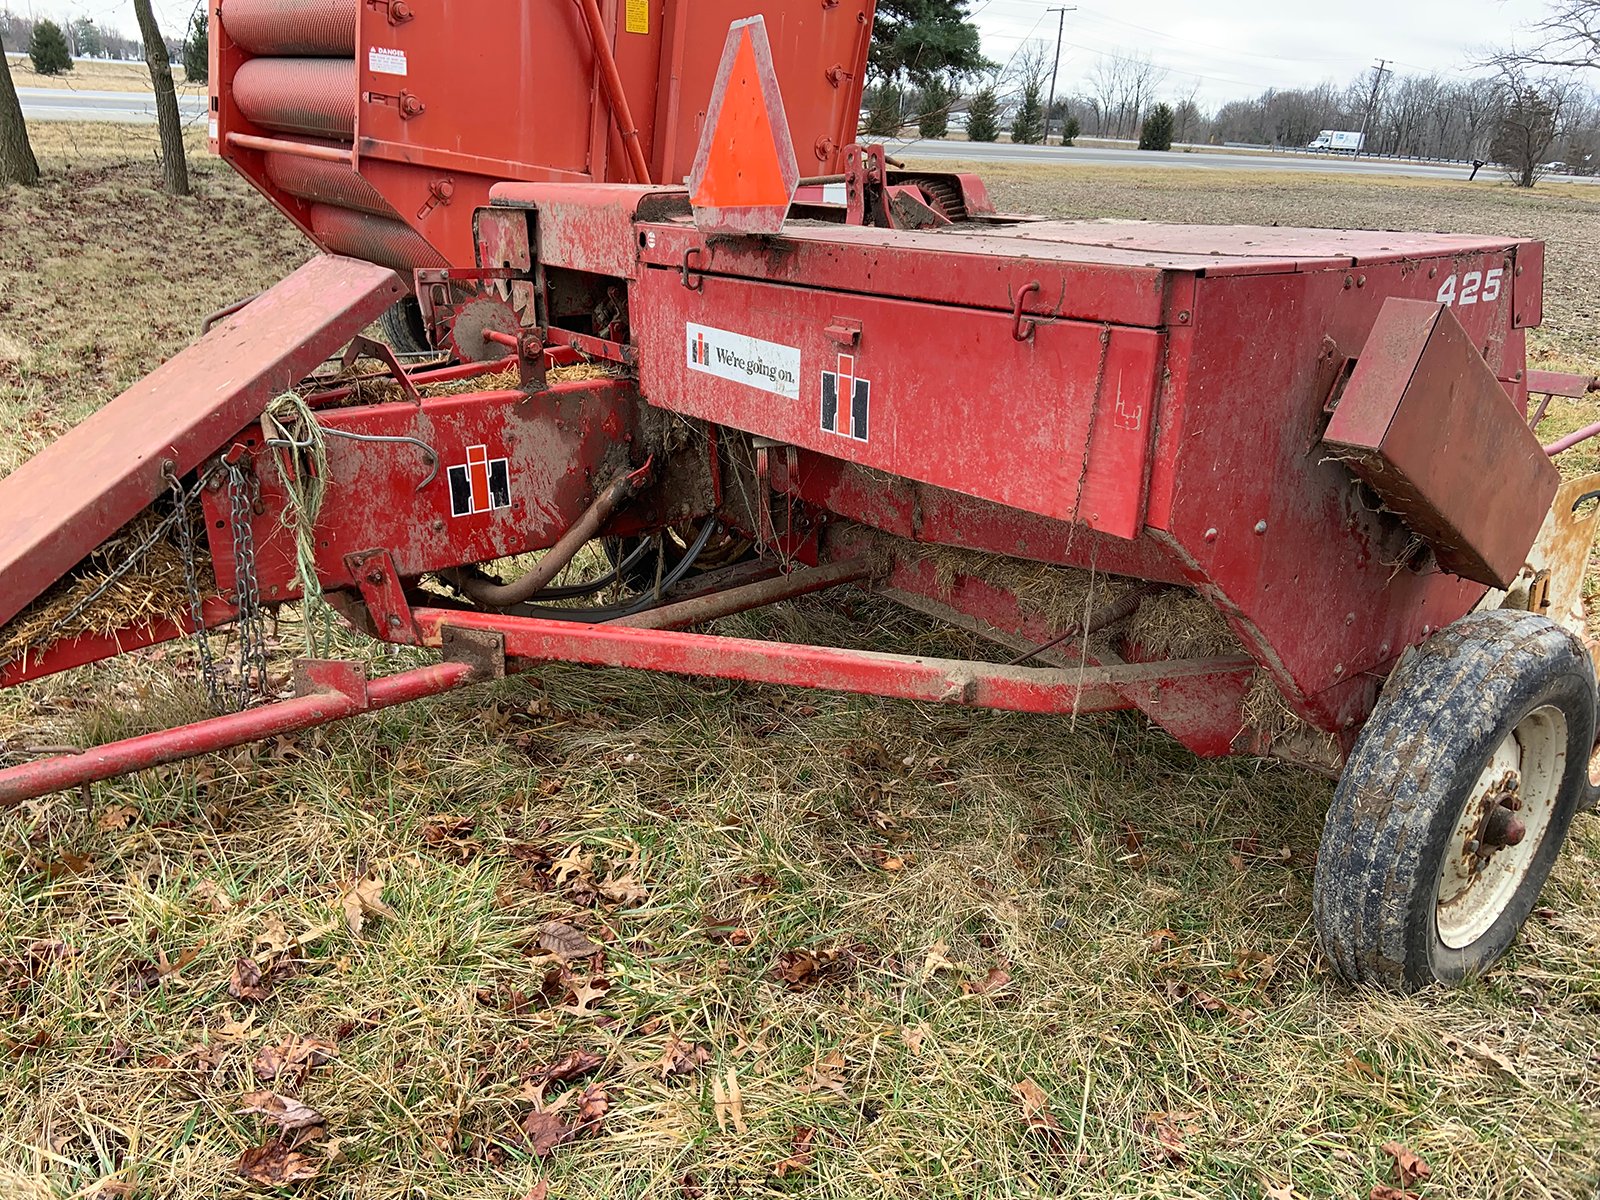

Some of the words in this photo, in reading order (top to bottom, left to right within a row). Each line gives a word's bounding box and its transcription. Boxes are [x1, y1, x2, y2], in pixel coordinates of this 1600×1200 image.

[1436, 268, 1504, 307] 425
[716, 347, 745, 370] We're
[746, 358, 777, 382] going
[778, 369, 795, 384] on.
